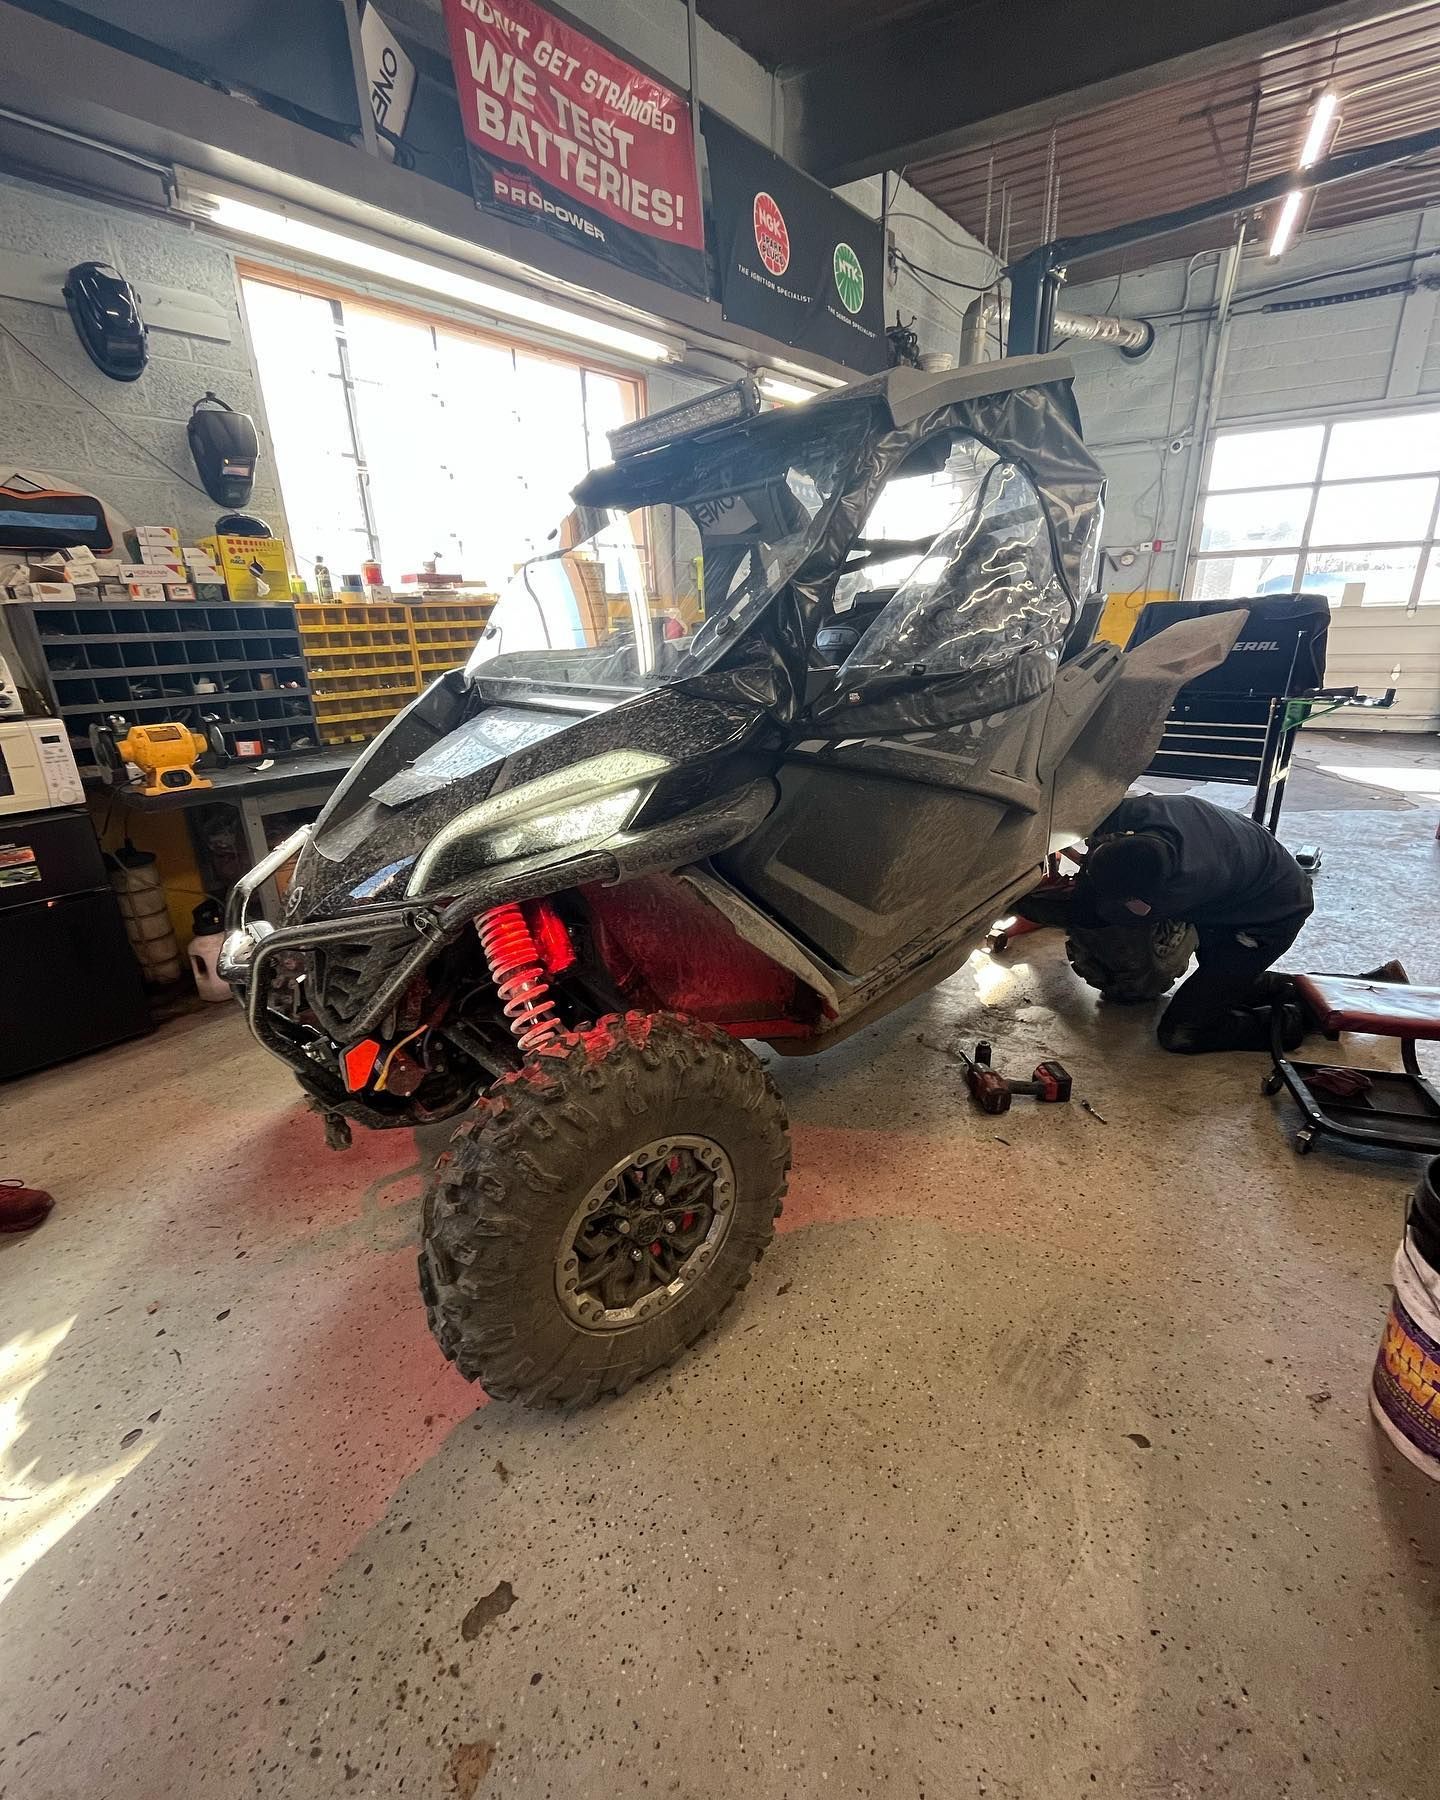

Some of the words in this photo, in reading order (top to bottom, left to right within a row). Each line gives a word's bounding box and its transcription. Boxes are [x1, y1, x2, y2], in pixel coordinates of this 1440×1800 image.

[372, 47, 397, 126] ONE
[464, 27, 537, 110] WE
[549, 86, 634, 169] TEST
[533, 40, 580, 82] GET
[581, 72, 676, 135] STRANDED
[476, 88, 684, 231] BATTERIES!
[759, 207, 782, 239] NGK
[737, 263, 749, 276] THE
[750, 271, 775, 290] IGNITION
[839, 259, 859, 283] NTK
[827, 305, 836, 316] THE
[1232, 641, 1280, 651] ERAL
